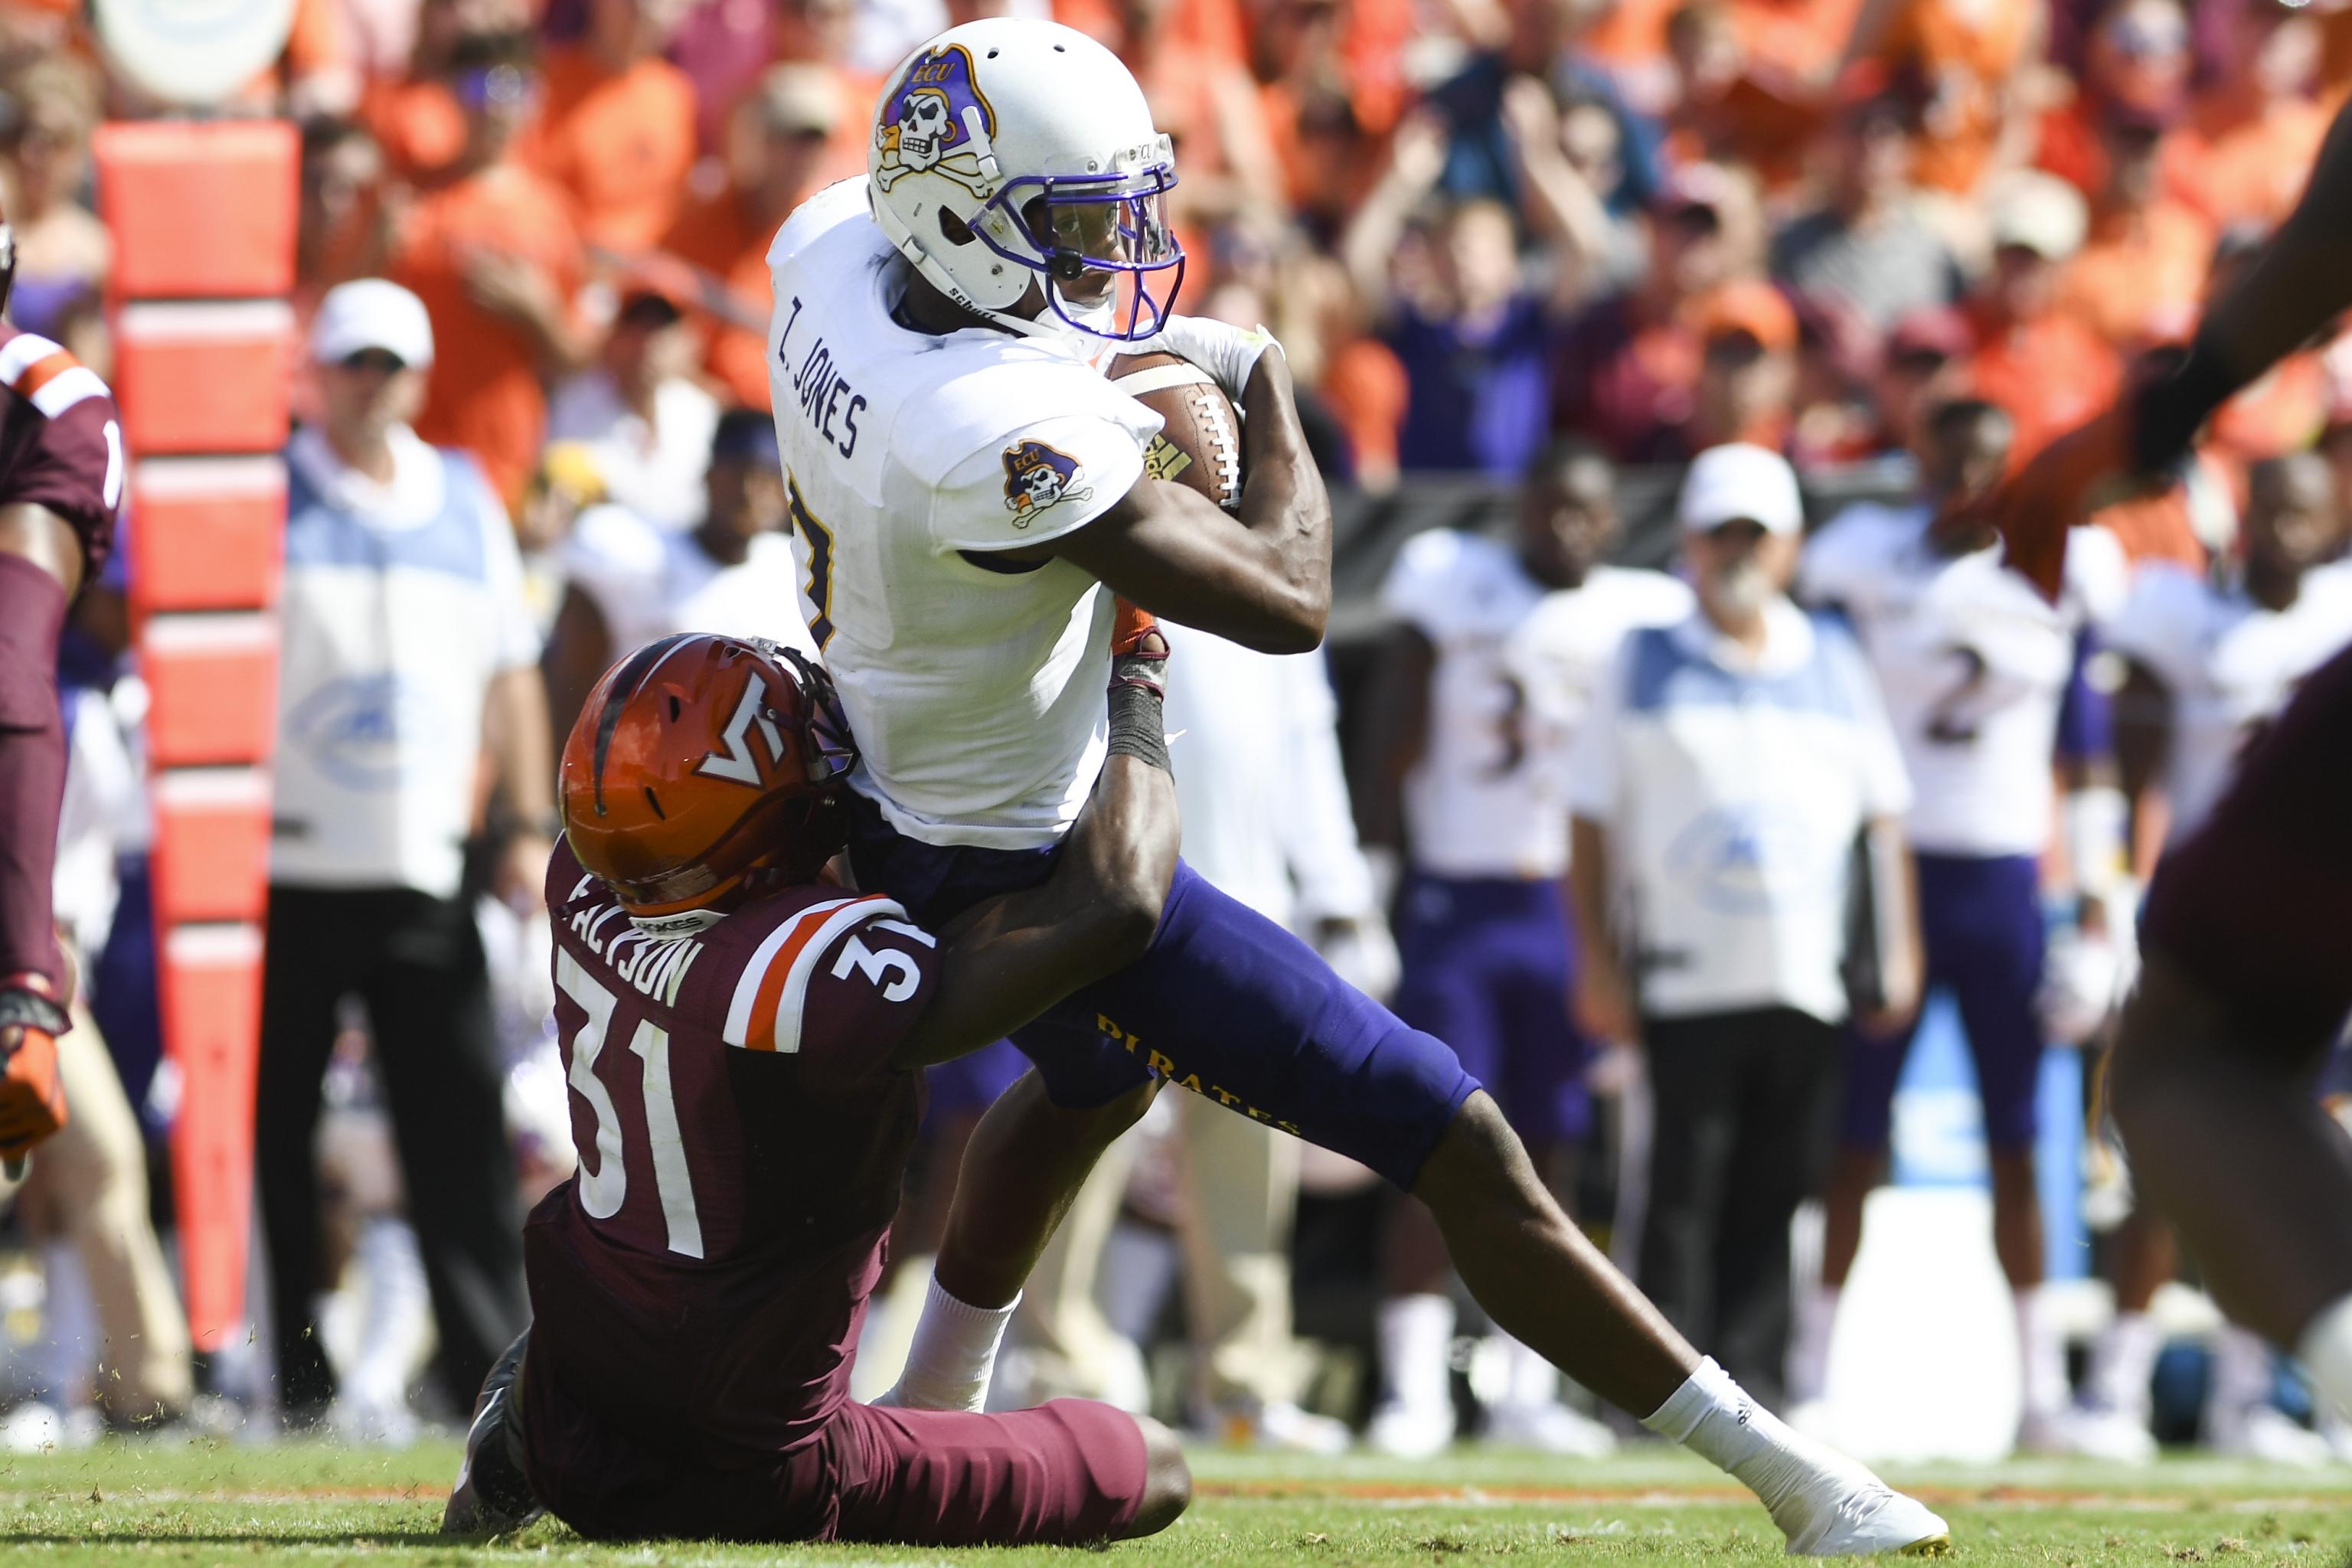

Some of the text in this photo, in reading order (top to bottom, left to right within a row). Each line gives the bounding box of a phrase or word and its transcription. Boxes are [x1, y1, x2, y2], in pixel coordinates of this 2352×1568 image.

[911, 62, 956, 83] ECU
[778, 296, 867, 459] Z. JONES
[1014, 449, 1041, 471] ECU
[1922, 642, 1991, 747] 2
[831, 920, 936, 1001] 31
[556, 944, 704, 1259] 31
